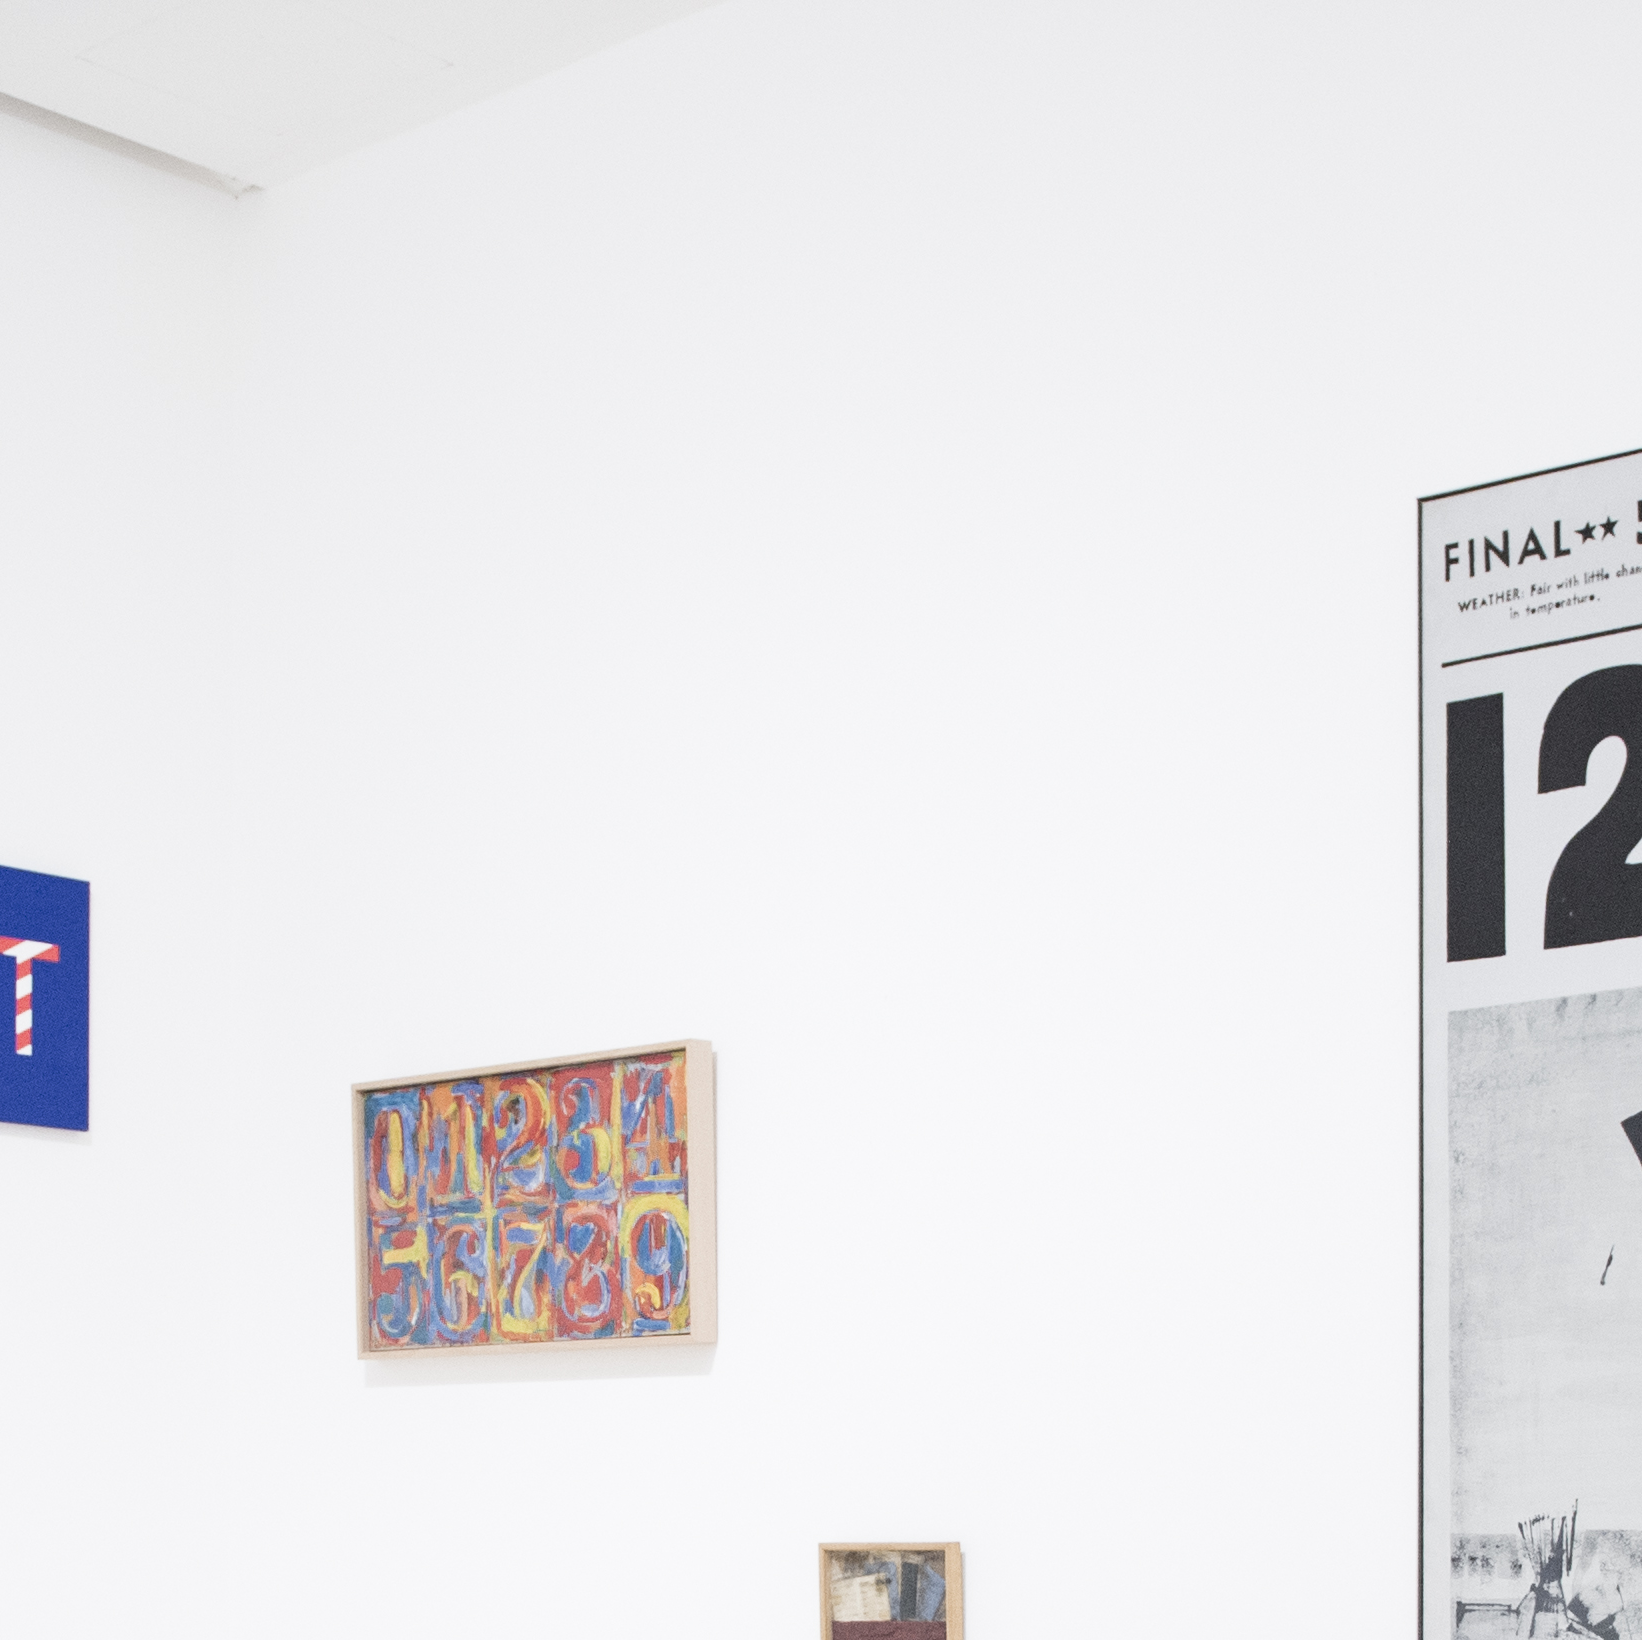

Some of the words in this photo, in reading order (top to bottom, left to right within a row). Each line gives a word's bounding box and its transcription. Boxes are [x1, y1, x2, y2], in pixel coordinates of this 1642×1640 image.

[1444, 520, 1571, 582] FINAL
[1458, 588, 1525, 612] WEATHER:
[1530, 583, 1552, 597] Fair
[1556, 574, 1580, 590] with
[1584, 568, 1610, 583] little
[1509, 608, 1520, 619] in
